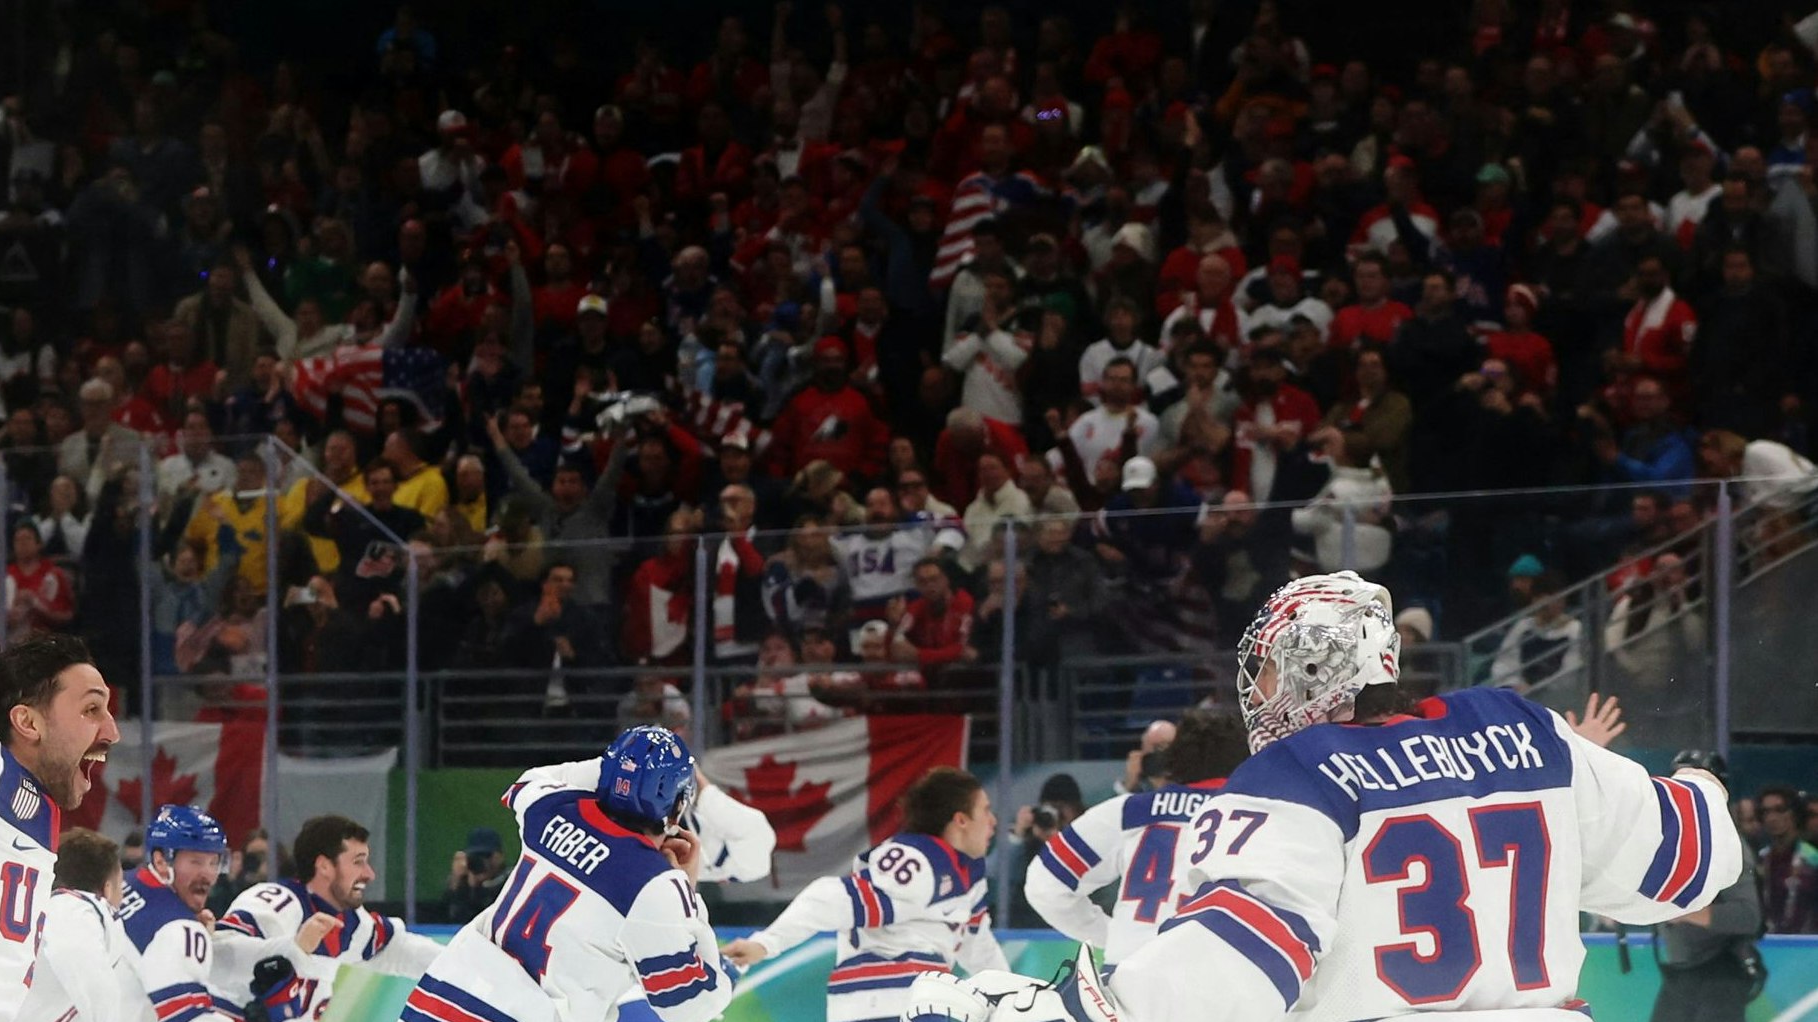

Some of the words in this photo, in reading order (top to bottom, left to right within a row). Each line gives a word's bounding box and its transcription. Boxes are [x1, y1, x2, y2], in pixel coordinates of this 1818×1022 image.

[1318, 722, 1544, 801] HELLEBUYCK
[23, 778, 39, 794] USA
[615, 777, 631, 796] 14
[539, 815, 610, 875] FABER
[1191, 809, 1269, 865] 37
[878, 848, 921, 885] 86
[256, 886, 293, 913] 21
[492, 854, 581, 986] 14
[1362, 801, 1552, 1005] 37
[183, 926, 208, 964] 10
